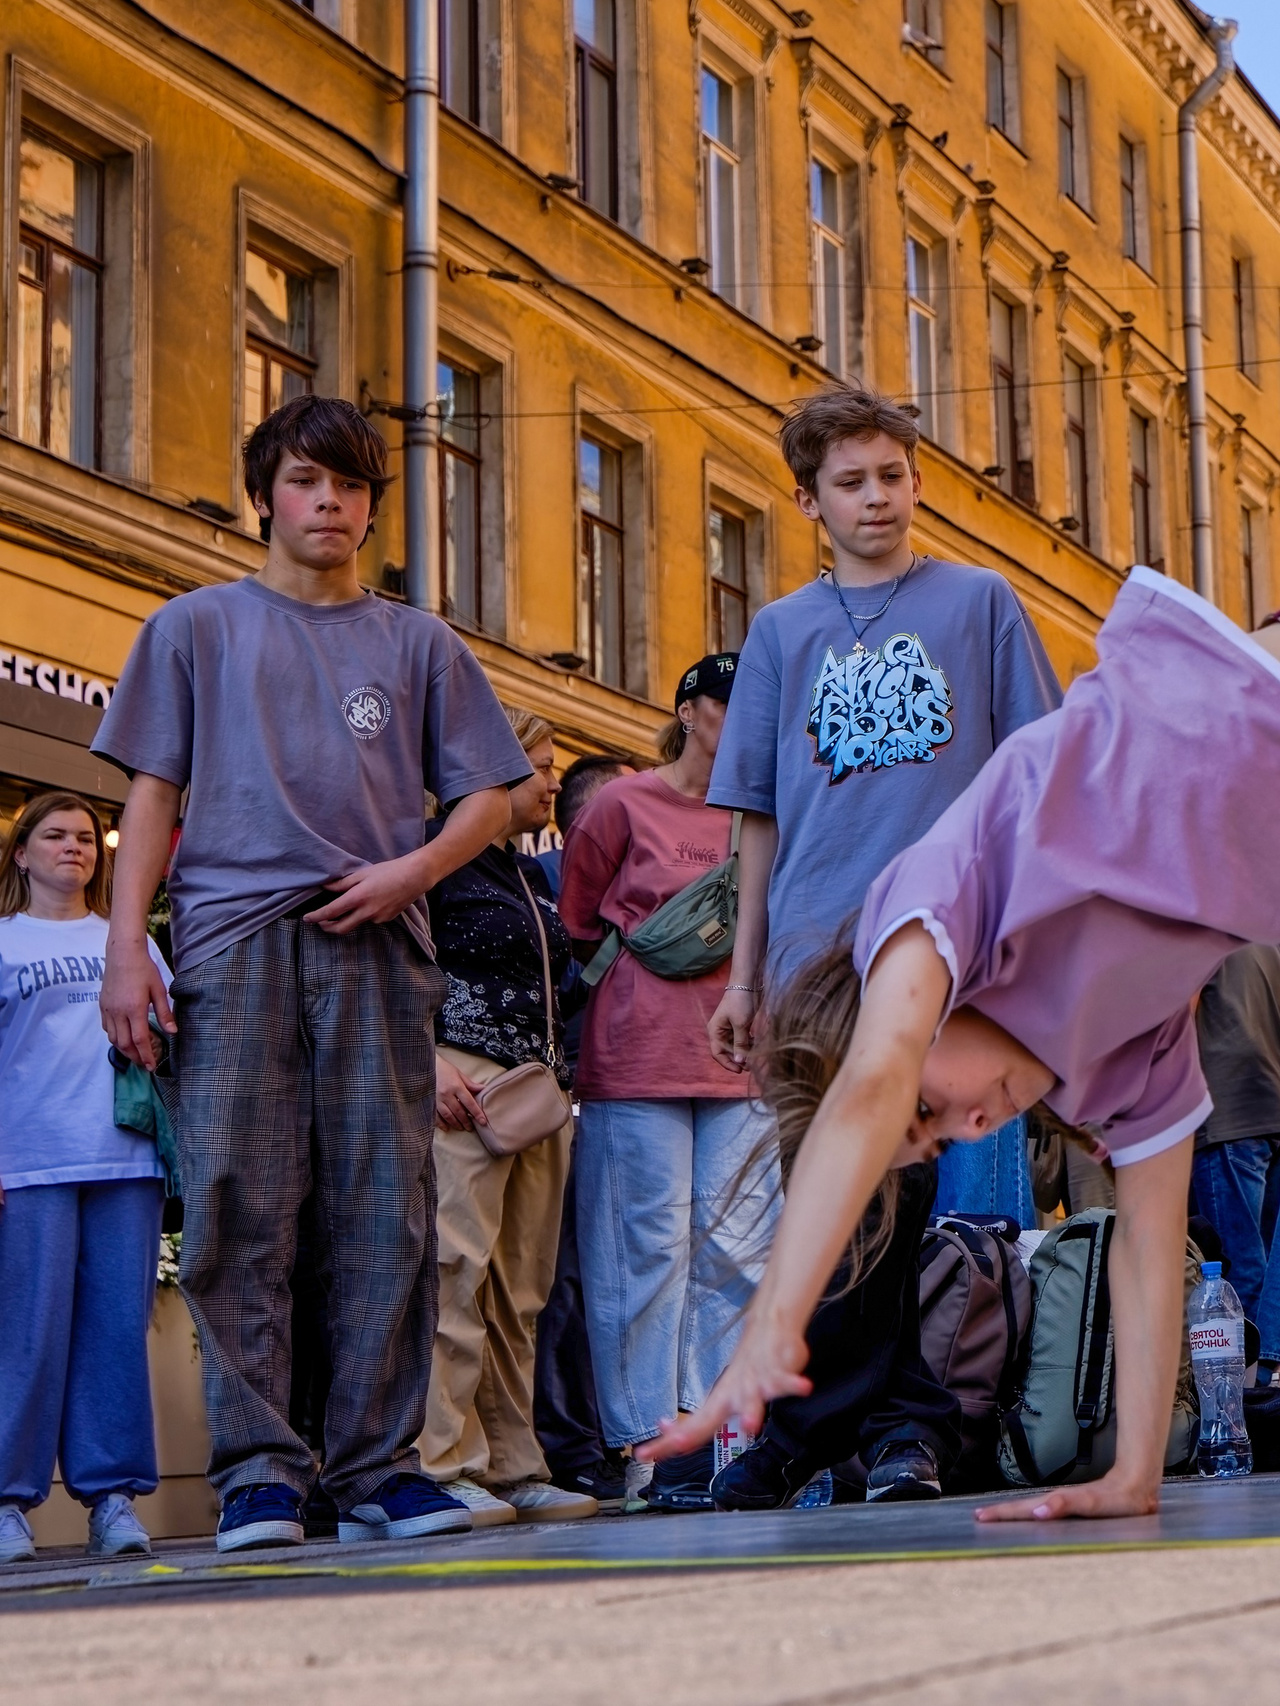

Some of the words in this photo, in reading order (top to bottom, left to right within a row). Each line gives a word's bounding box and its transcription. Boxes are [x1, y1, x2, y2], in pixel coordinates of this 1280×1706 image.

[717, 660, 734, 673] 75
[17, 956, 106, 1001] CHARM
[67, 991, 101, 1004] CREATUR
[1190, 1338, 1231, 1351] СТОЧНИК
